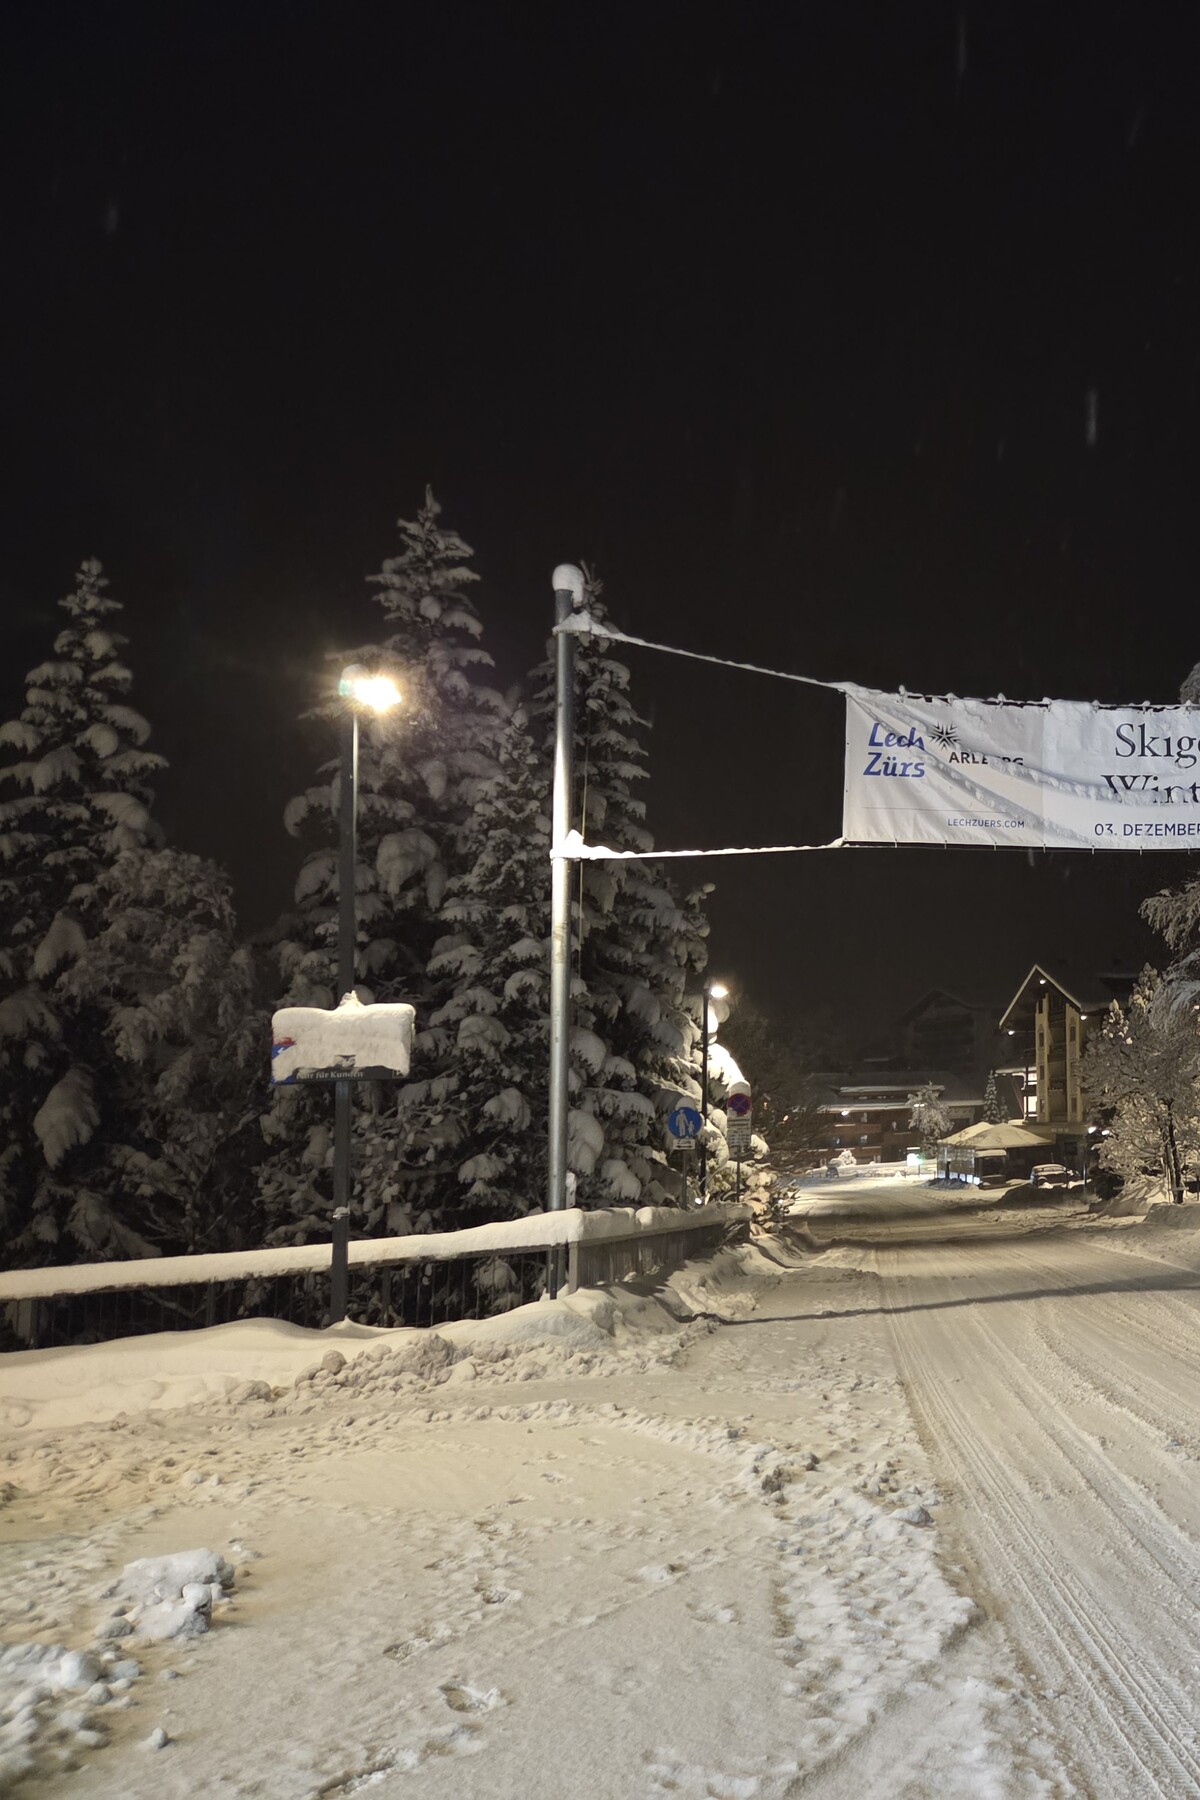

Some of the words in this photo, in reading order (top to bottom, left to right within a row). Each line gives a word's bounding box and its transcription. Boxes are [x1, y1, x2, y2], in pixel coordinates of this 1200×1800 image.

[868, 722, 925, 750] Lech
[863, 752, 925, 777] Zürs
[947, 818, 1025, 829] LECHZUERS.COM
[1094, 823, 1118, 836] 03.
